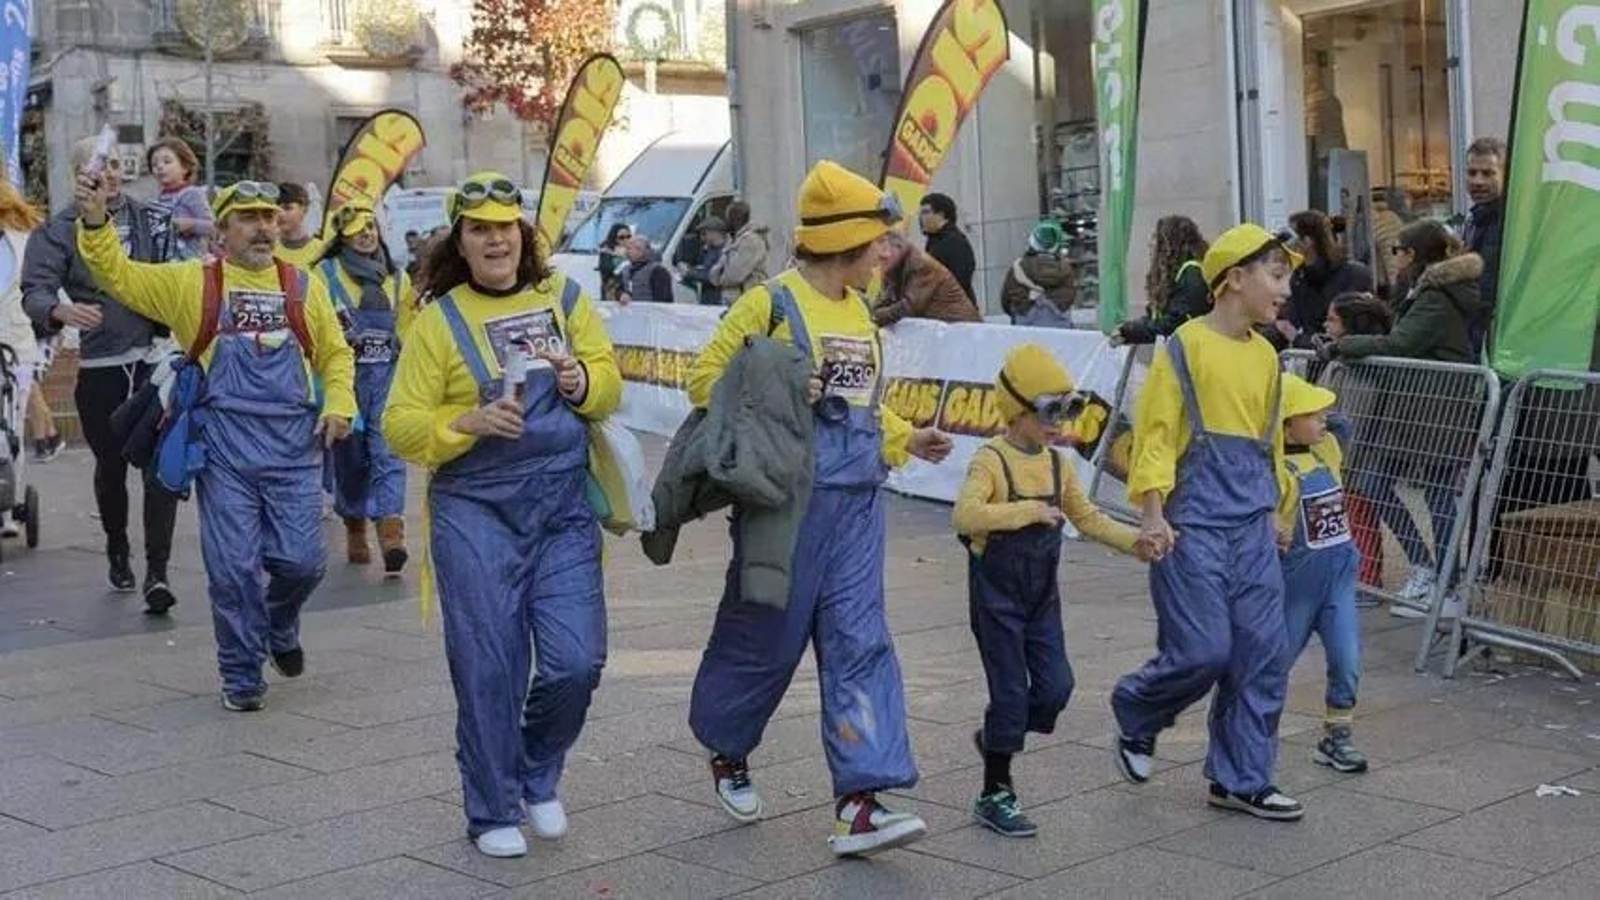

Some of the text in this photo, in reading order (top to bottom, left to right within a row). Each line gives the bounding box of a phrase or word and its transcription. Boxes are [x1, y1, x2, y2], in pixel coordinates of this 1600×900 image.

[896, 0, 1007, 173] DIS
[829, 363, 874, 387] 2539
[945, 386, 1004, 430] GAD
[1316, 514, 1349, 539] 253
